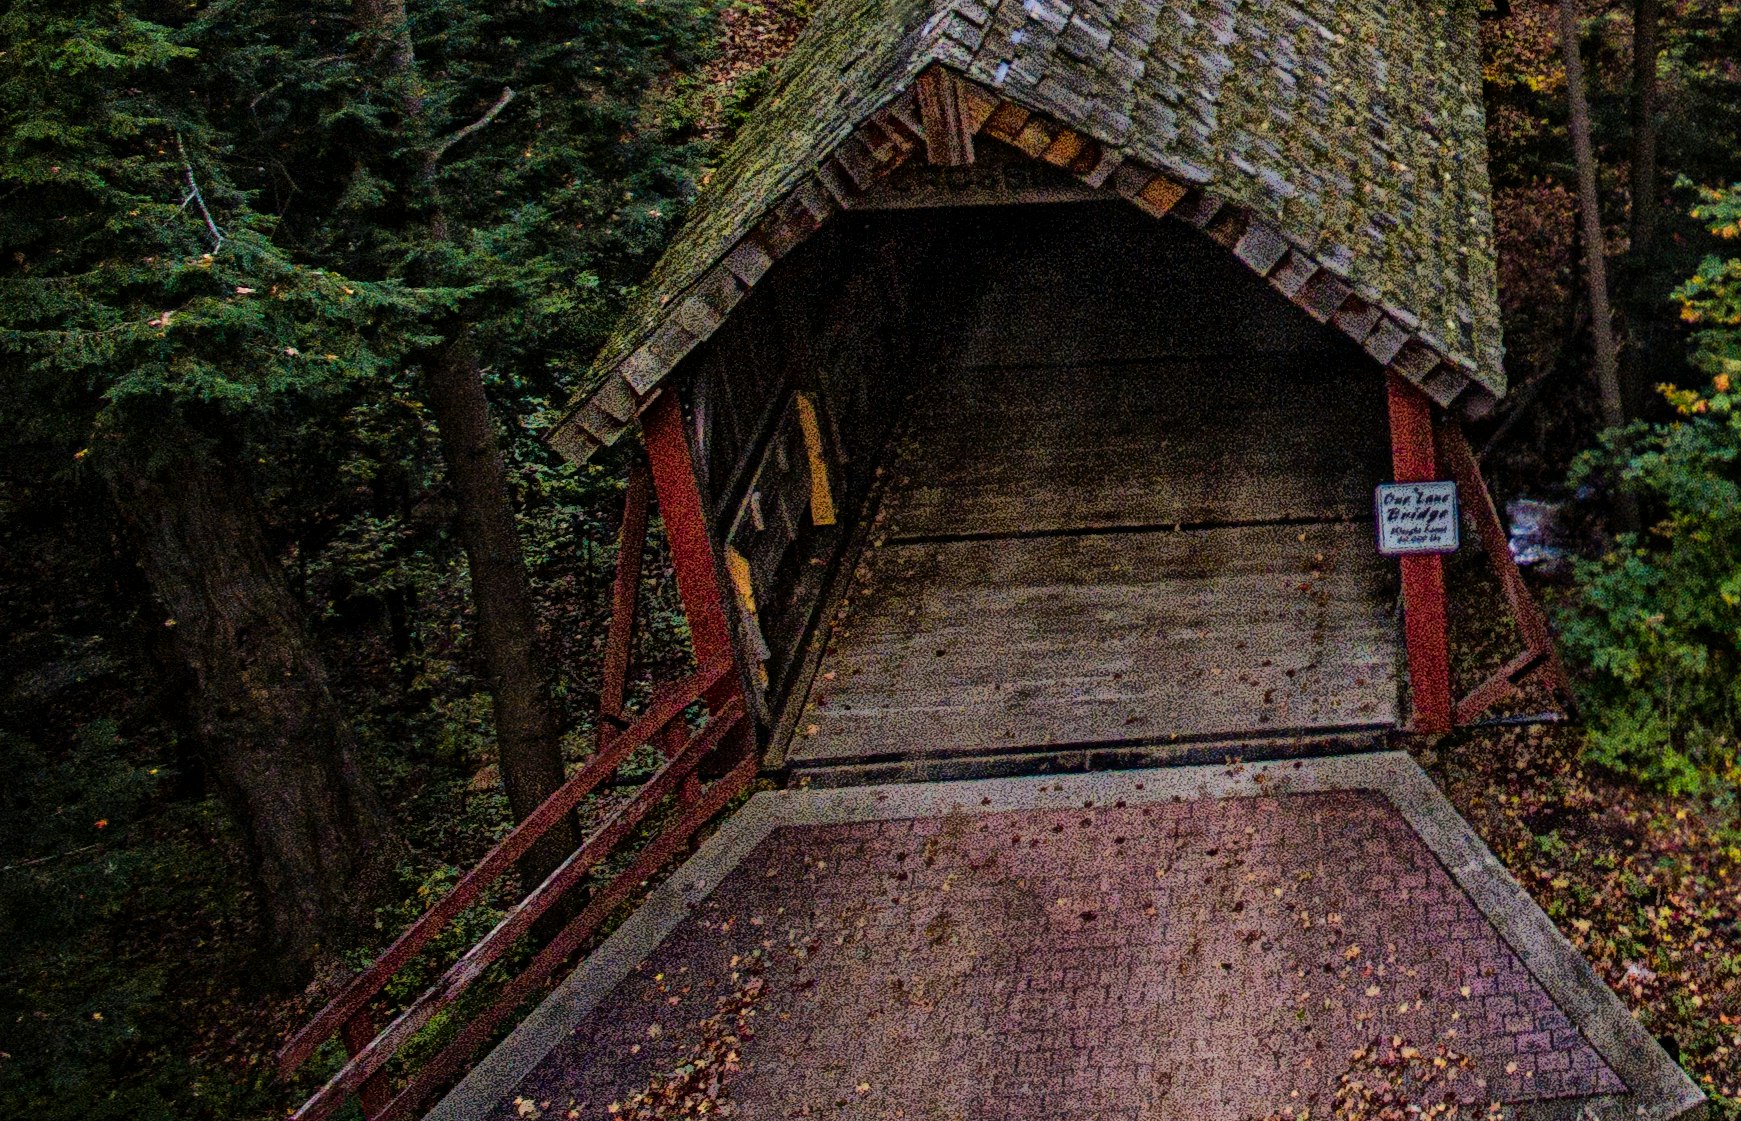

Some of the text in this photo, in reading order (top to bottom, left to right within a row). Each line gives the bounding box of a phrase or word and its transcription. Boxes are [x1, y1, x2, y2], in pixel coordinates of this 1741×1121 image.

[1384, 491, 1450, 506] One Lane
[1387, 507, 1449, 523] Bridge
